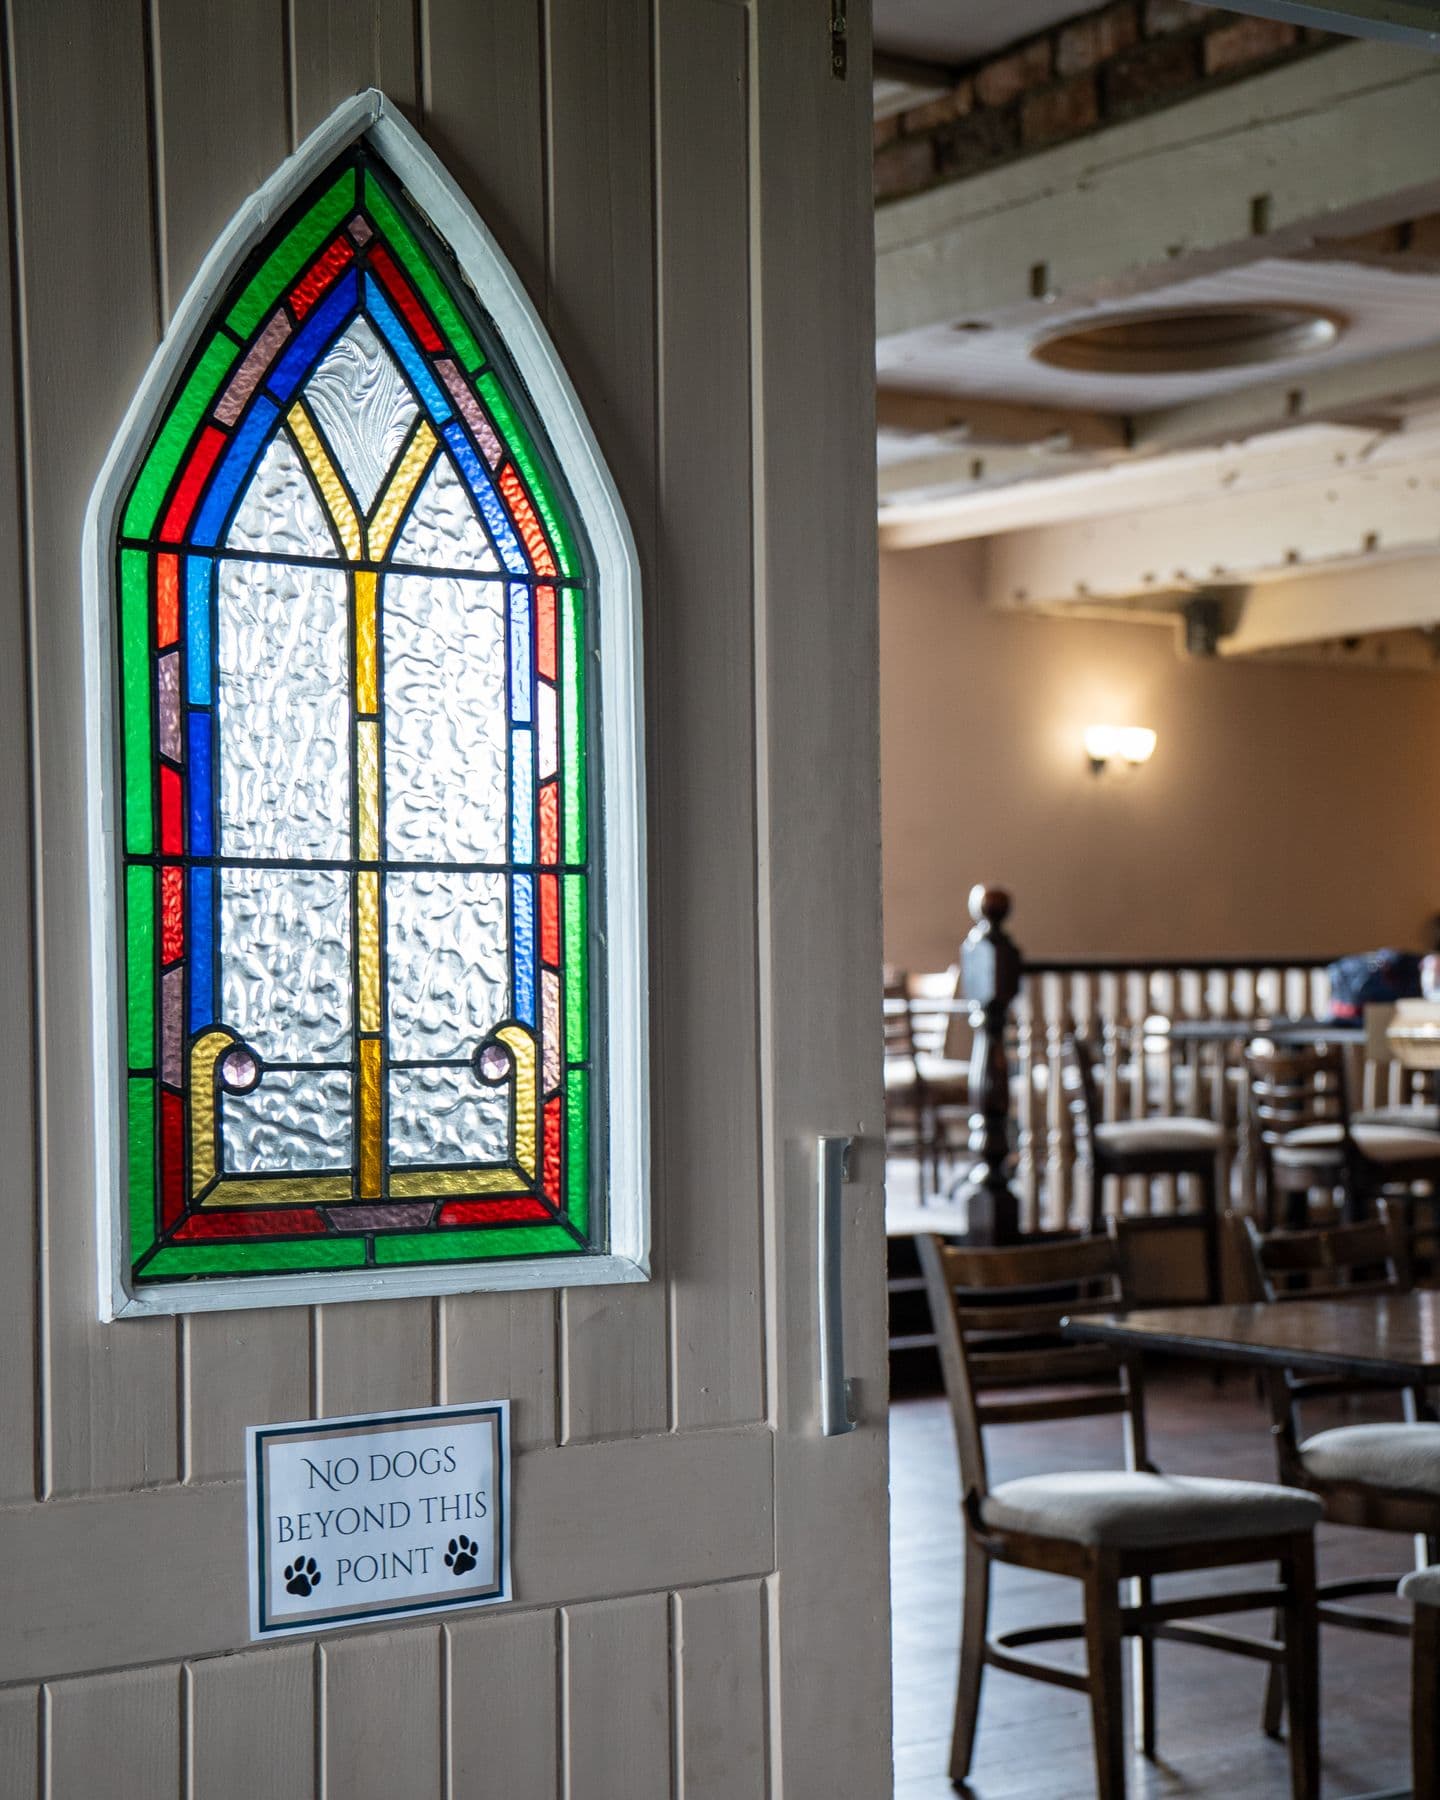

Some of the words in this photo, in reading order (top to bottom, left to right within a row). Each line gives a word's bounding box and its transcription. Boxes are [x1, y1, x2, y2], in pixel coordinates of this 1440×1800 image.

[301, 1457, 359, 1491] NO
[369, 1446, 456, 1482] DOGS
[277, 1501, 411, 1543] BEYOND
[419, 1491, 487, 1524] THIS
[336, 1546, 434, 1586] POINT
